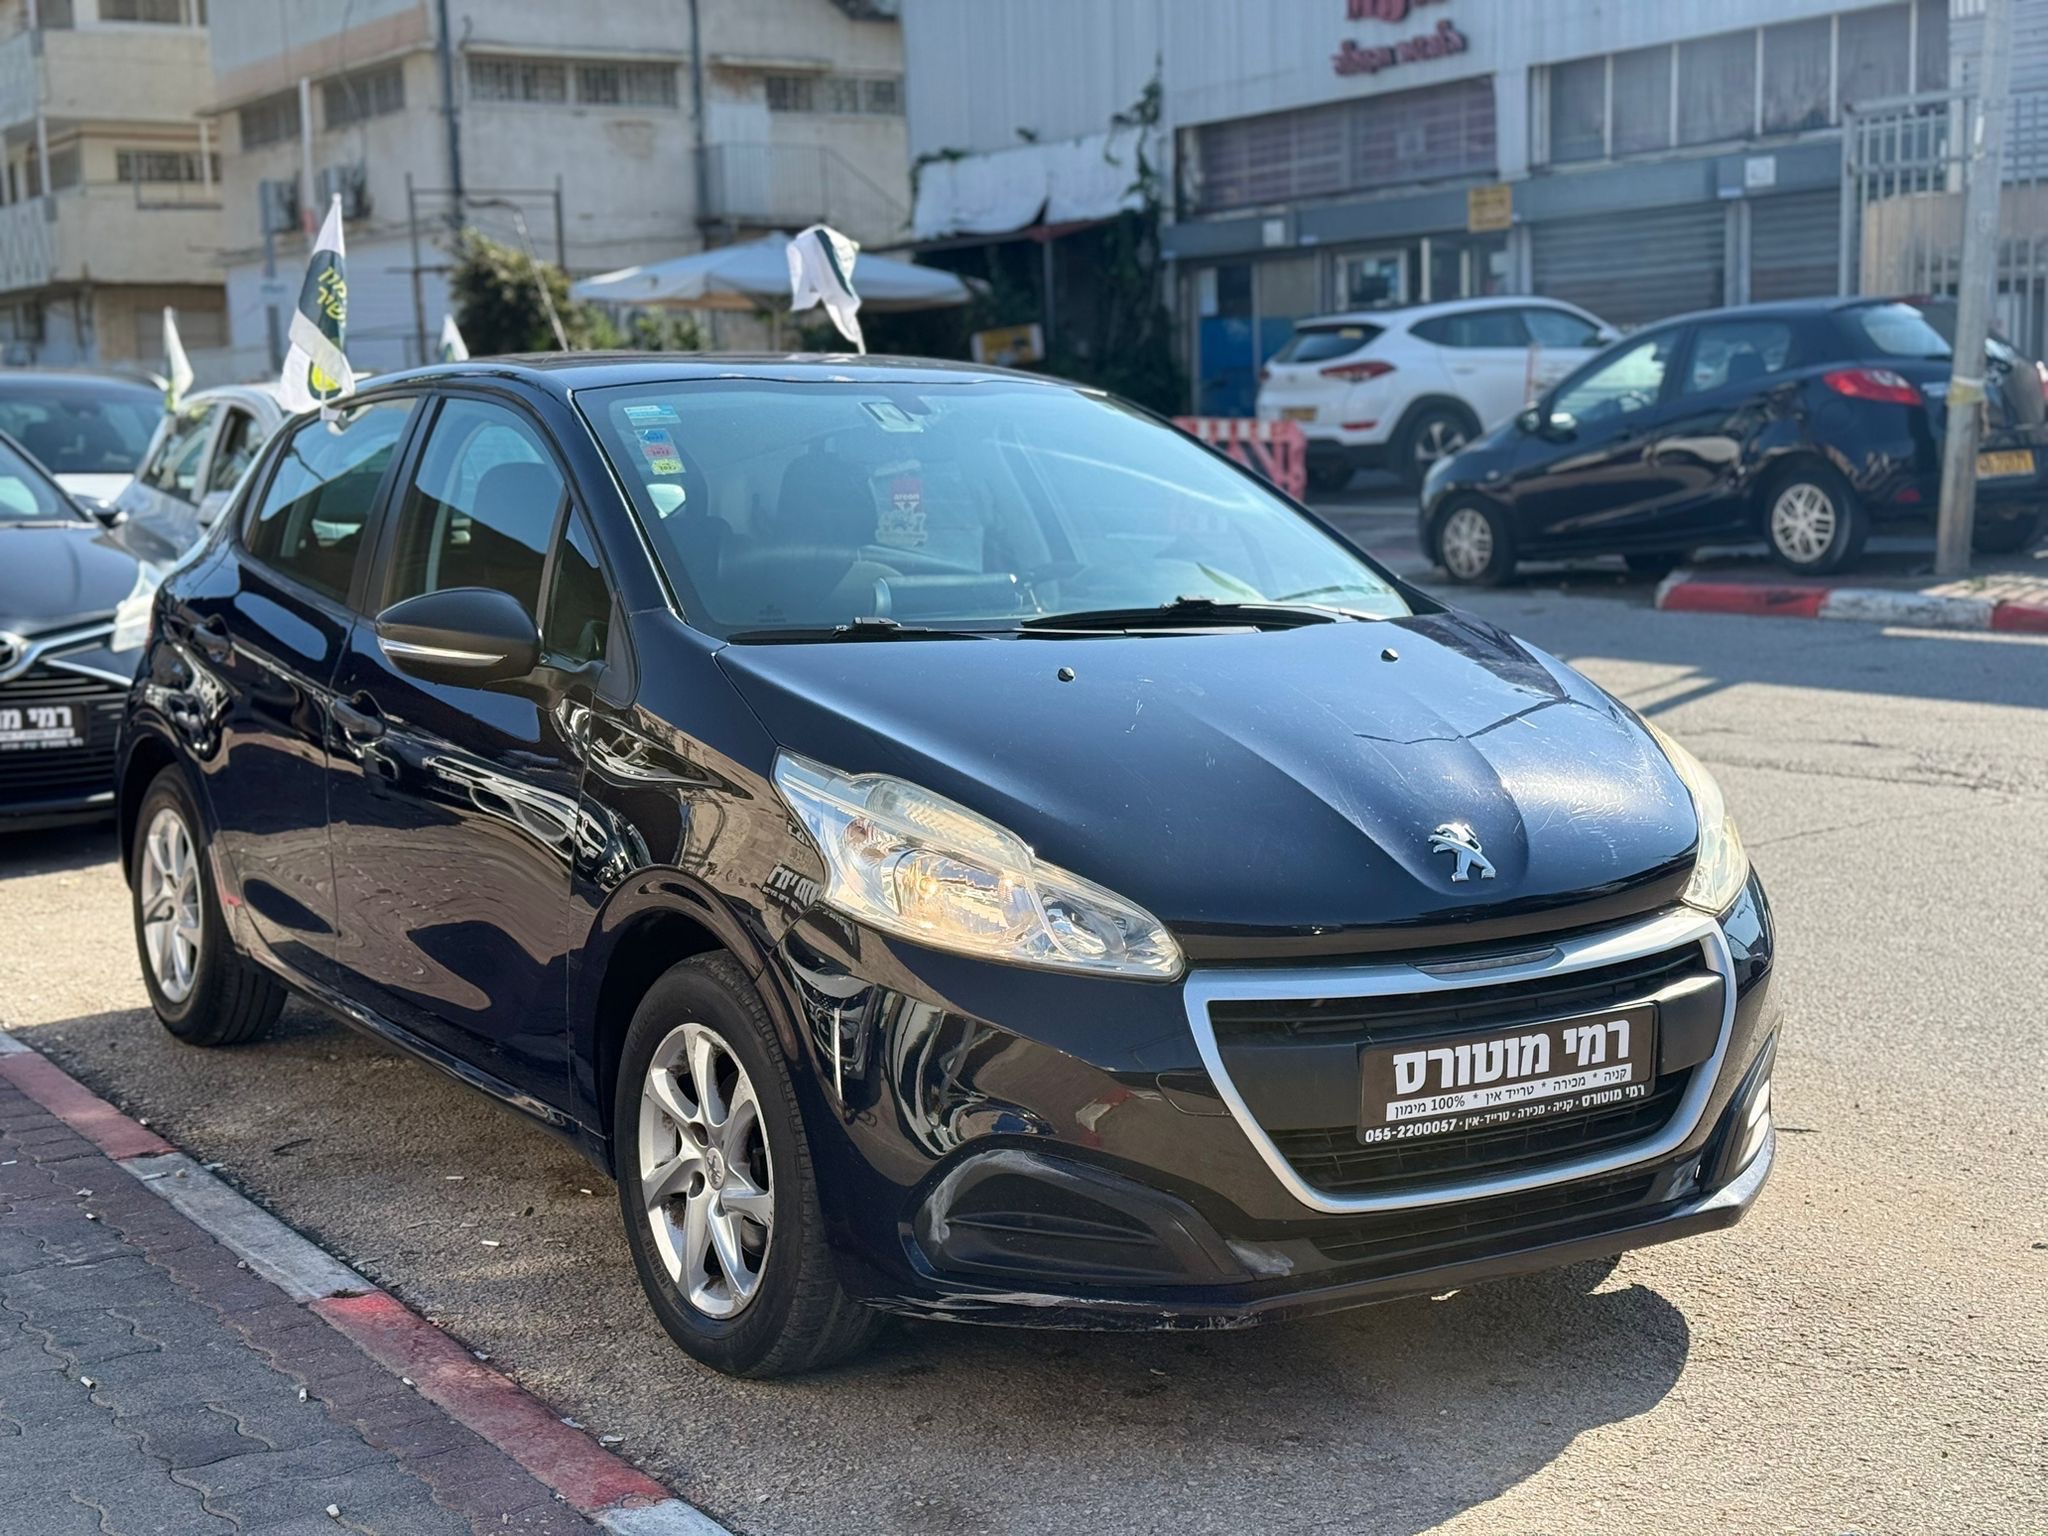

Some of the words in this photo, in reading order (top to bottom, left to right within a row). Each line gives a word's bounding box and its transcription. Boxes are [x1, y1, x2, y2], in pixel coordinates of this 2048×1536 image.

[27, 706, 72, 729] רמי
[1563, 1020, 1630, 1067] רמי
[1393, 1033, 1550, 1095] מוטורס
[1604, 1068, 1627, 1082] קניה
[1553, 1076, 1586, 1091] מכירה
[1626, 1084, 1645, 1097] רמי
[1486, 1091, 1501, 1106] אין
[1505, 1085, 1535, 1099] טרייד
[1582, 1088, 1622, 1107] מוטורס
[1395, 1103, 1426, 1119] מימון
[1431, 1095, 1465, 1111] 100%
[1553, 1099, 1573, 1112] קניה
[1518, 1104, 1545, 1119] מכירה
[1465, 1112, 1510, 1130] טרייד-אין
[1365, 1119, 1457, 1142] 055-2200057
